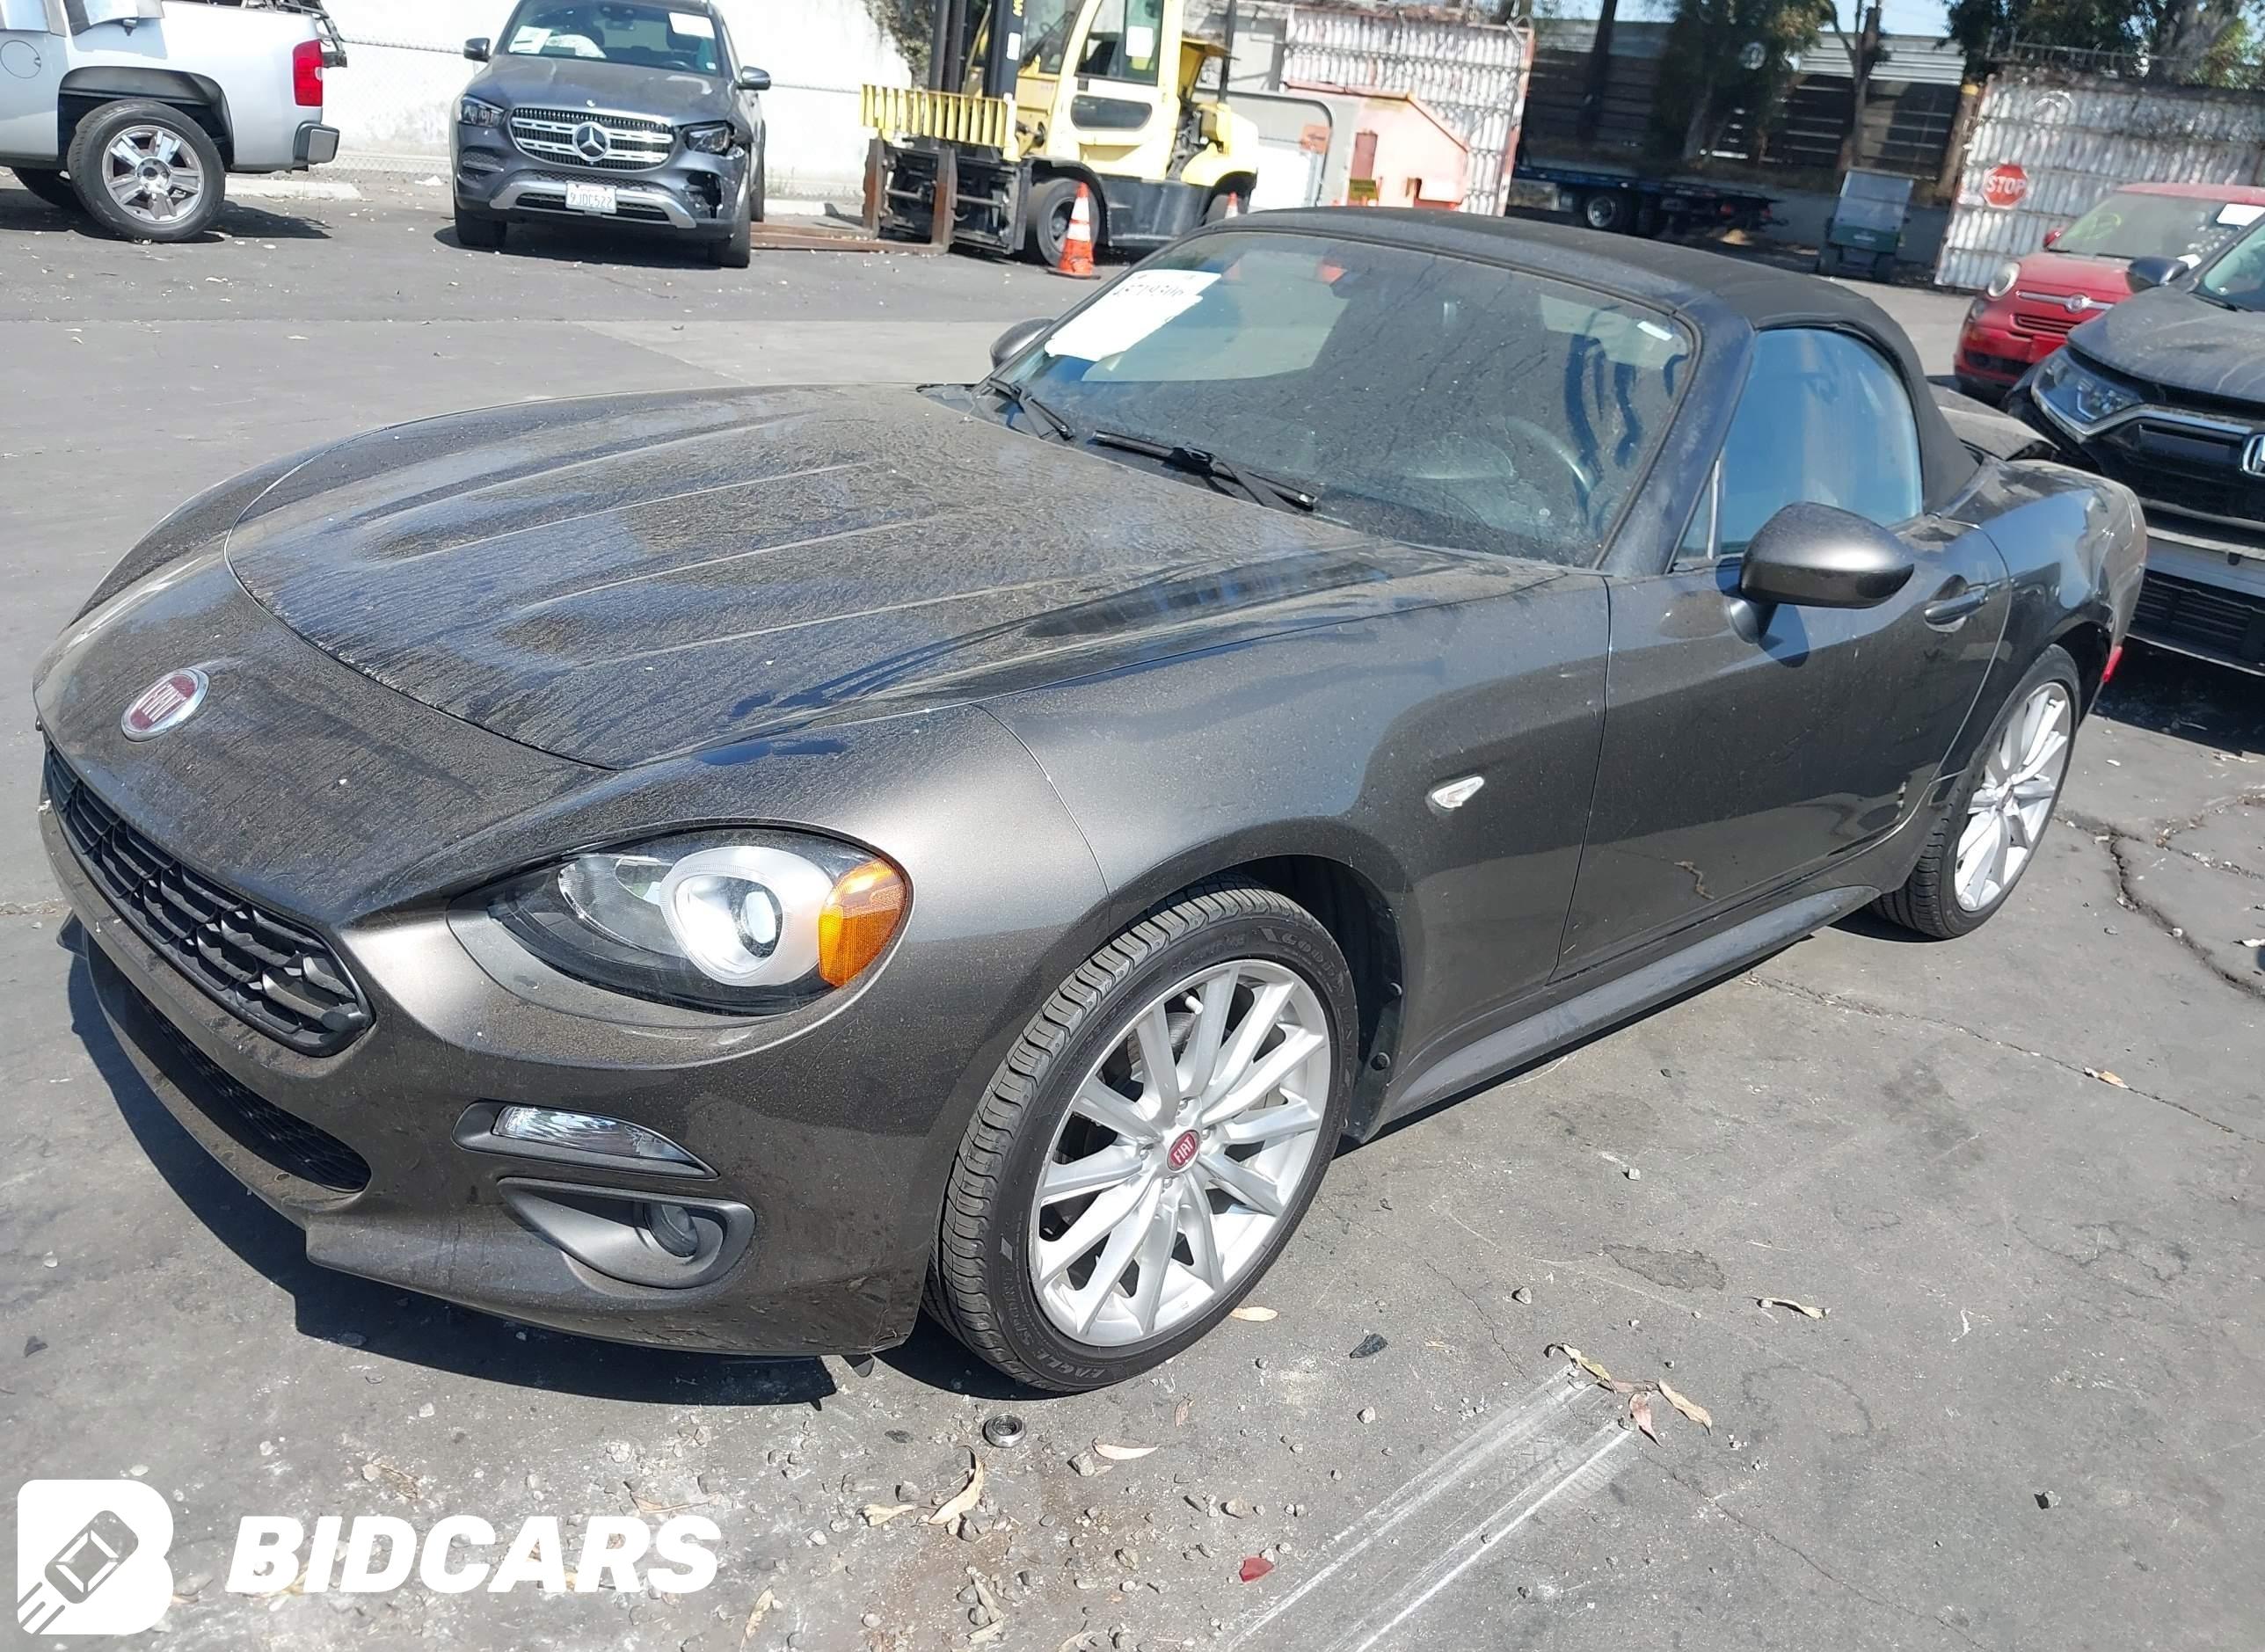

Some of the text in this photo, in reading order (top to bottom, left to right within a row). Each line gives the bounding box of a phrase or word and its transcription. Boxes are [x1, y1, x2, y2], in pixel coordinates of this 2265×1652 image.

[1986, 176, 2027, 196] STOP
[570, 192, 613, 207] 9JDC522
[1173, 1137, 1193, 1163] FIAT
